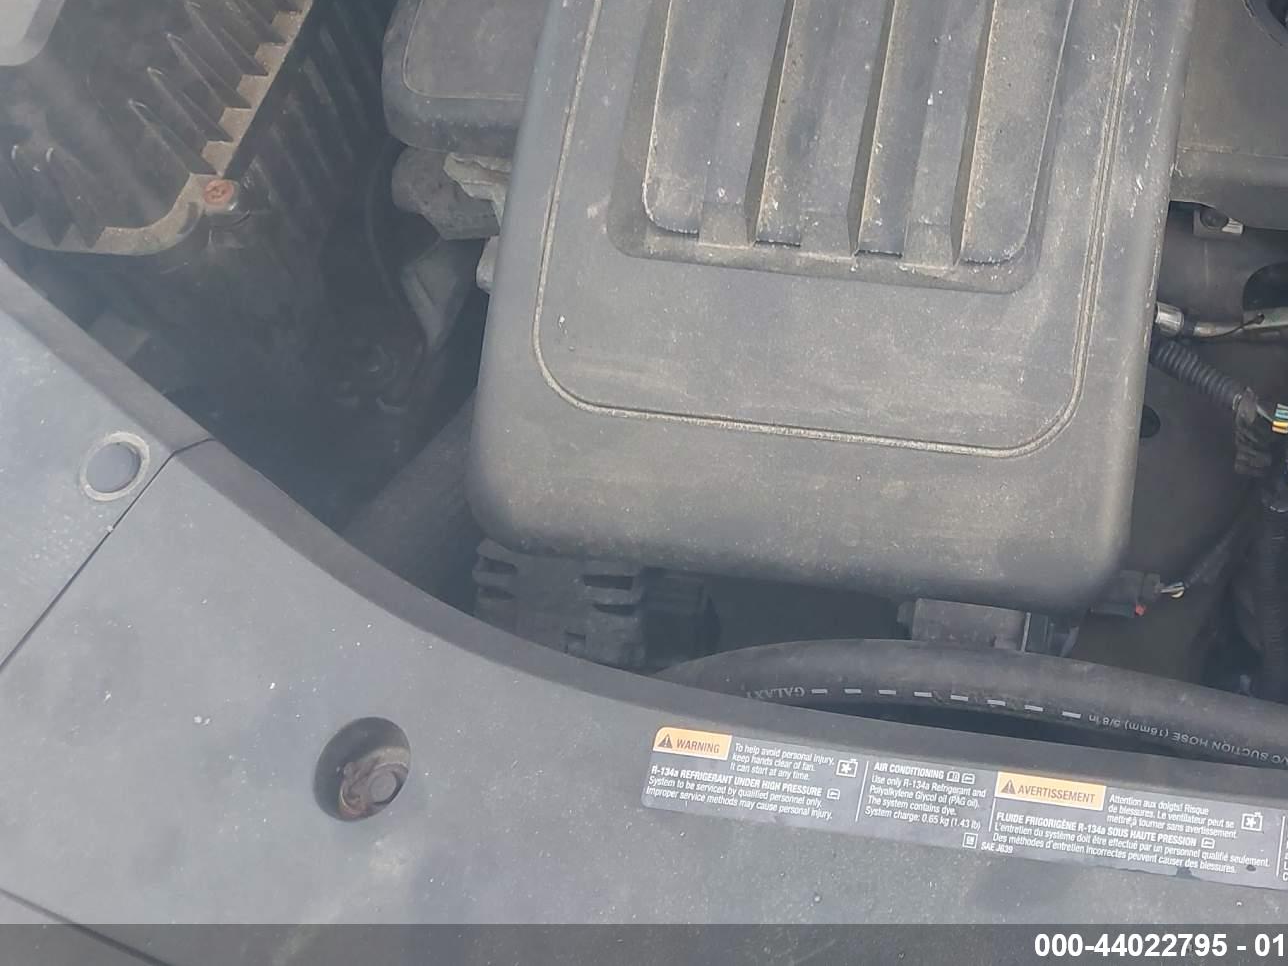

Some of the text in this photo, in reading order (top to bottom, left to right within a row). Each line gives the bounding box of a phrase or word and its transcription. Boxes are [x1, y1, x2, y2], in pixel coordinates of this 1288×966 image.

[676, 738, 720, 753] WARNING
[1171, 732, 1208, 747] HOSE
[735, 743, 743, 751] To
[744, 744, 760, 755] help
[761, 747, 781, 756] avoid
[781, 749, 812, 762] personal
[1211, 741, 1269, 761] SUCTION
[730, 762, 735, 770] It
[750, 765, 767, 774] start
[768, 767, 777, 776] at
[777, 770, 791, 779] any
[793, 771, 809, 780] time.
[731, 753, 815, 771] keep hands clear of fan.
[874, 762, 944, 779] AIR CONDITIONING
[648, 776, 675, 788] System
[676, 779, 684, 788] to
[685, 780, 694, 789] be
[695, 782, 726, 793] serviced
[726, 786, 736, 796] by
[737, 787, 768, 800] qualified
[769, 791, 805, 805] personnel
[651, 765, 822, 796] R-134a REFRIGERANT UNDER HIGH PRESSURE
[871, 774, 986, 797] Use only R-134a Refrigerant and
[645, 786, 678, 799] Improper
[679, 790, 705, 801] service
[706, 794, 738, 805] methods
[738, 800, 754, 809] may
[756, 802, 777, 810] cause
[778, 803, 809, 816] personal
[914, 791, 937, 803] Glycol
[938, 794, 947, 802] oil
[948, 795, 965, 807] (PAG
[1017, 783, 1095, 803] AVERTISSEMENT
[867, 795, 957, 816] The system contains dye.
[1109, 794, 1141, 805] Attention
[1183, 804, 1208, 816] Risque
[864, 806, 981, 830] System charge: 0.65 kg (1.43 lb)
[1107, 814, 1130, 824] mettre
[1138, 818, 1164, 828] tourner
[1184, 825, 1237, 838] avertissement.
[1108, 804, 1117, 812] de
[1119, 805, 1155, 817] blessures.
[1157, 810, 1166, 819] Le
[1167, 812, 1206, 824] ventilateur
[1207, 817, 1224, 828] peut
[996, 812, 1023, 823] FLUIDE
[1077, 822, 1106, 834] R-134a
[1107, 826, 1128, 837] SOUS
[1129, 829, 1155, 840] HAUTE
[1157, 833, 1196, 846] PRESSION
[981, 841, 994, 851] SAE
[992, 833, 1007, 843] Des
[1086, 845, 1126, 858] incorrectes
[1127, 851, 1157, 863] peuvent
[1158, 856, 1183, 865] causer
[1184, 858, 1198, 867] des
[1200, 860, 1236, 872] blessures.
[1034, 828, 1043, 837] du
[1076, 833, 1090, 843] doit
[1139, 843, 1152, 852] par
[1164, 845, 1200, 858] personnel
[1230, 853, 1270, 866] seulement.
